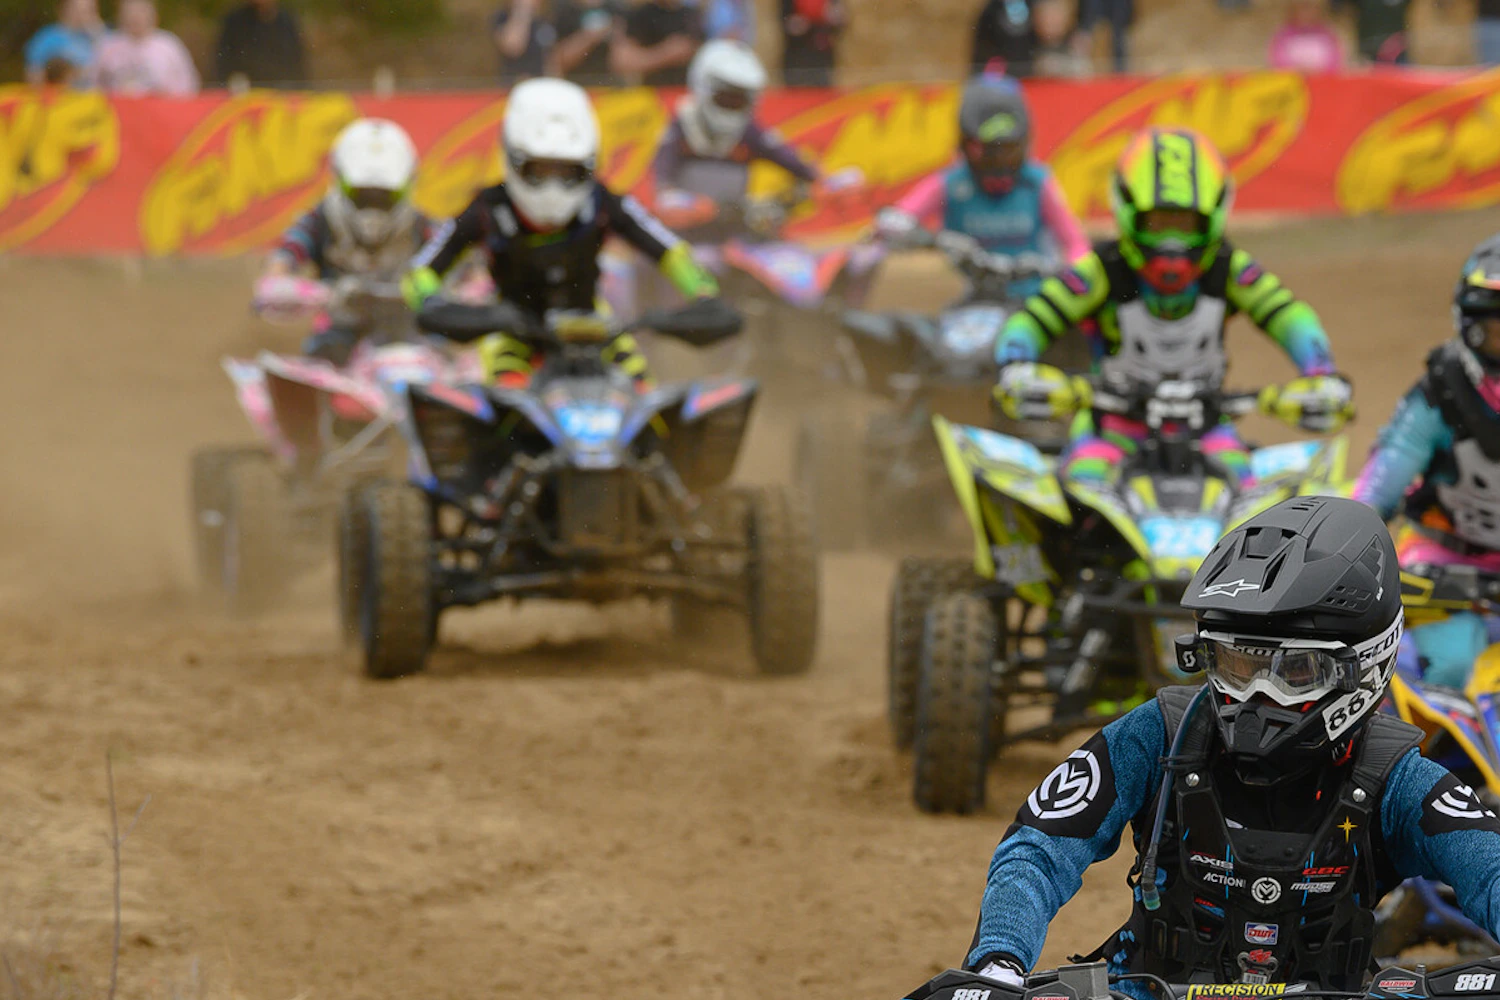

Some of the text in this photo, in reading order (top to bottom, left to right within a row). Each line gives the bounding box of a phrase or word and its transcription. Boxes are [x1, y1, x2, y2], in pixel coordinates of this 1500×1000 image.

[1360, 622, 1402, 663] SCOT
[1190, 854, 1234, 870] AXIS
[1302, 866, 1349, 875] GBC
[1378, 980, 1416, 988] BALDWIN
[1454, 973, 1496, 992] 881
